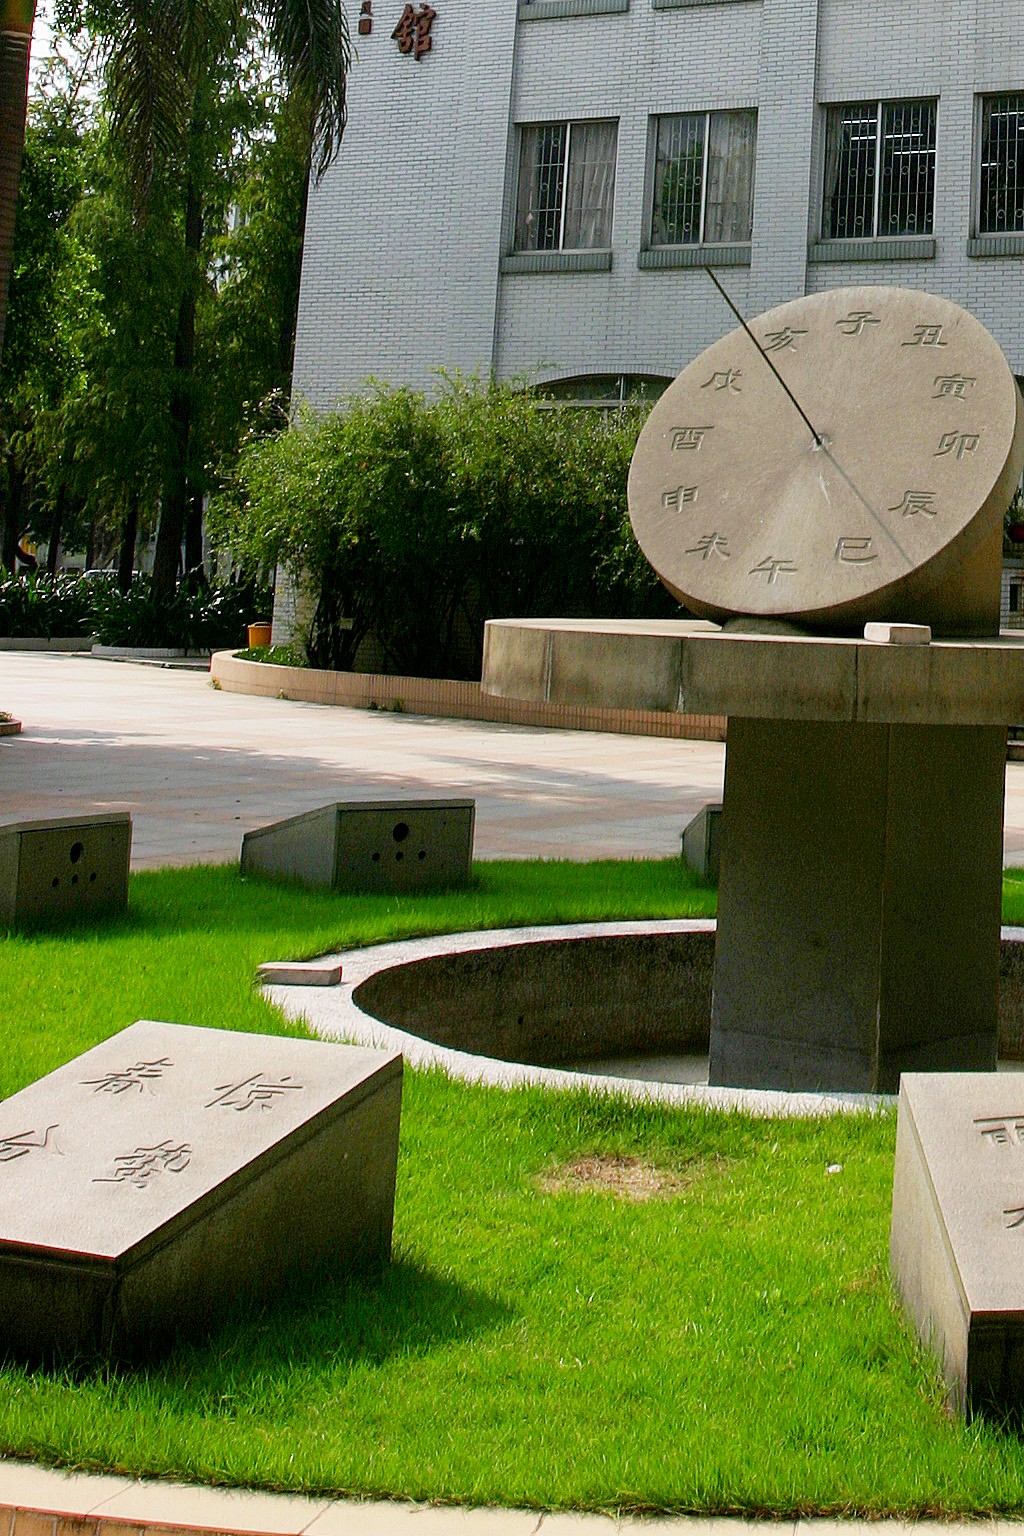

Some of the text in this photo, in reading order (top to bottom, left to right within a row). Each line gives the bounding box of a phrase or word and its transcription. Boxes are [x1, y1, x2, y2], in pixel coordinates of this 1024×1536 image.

[836, 311, 881, 336] 子
[900, 324, 948, 349] 丑
[763, 326, 808, 353] 亥
[931, 374, 977, 401] 寅
[669, 425, 714, 451] 酉
[933, 429, 980, 460] 卯
[661, 486, 698, 513] 申
[888, 489, 938, 519] 辰
[685, 532, 731, 561] 未
[748, 555, 798, 584] 午
